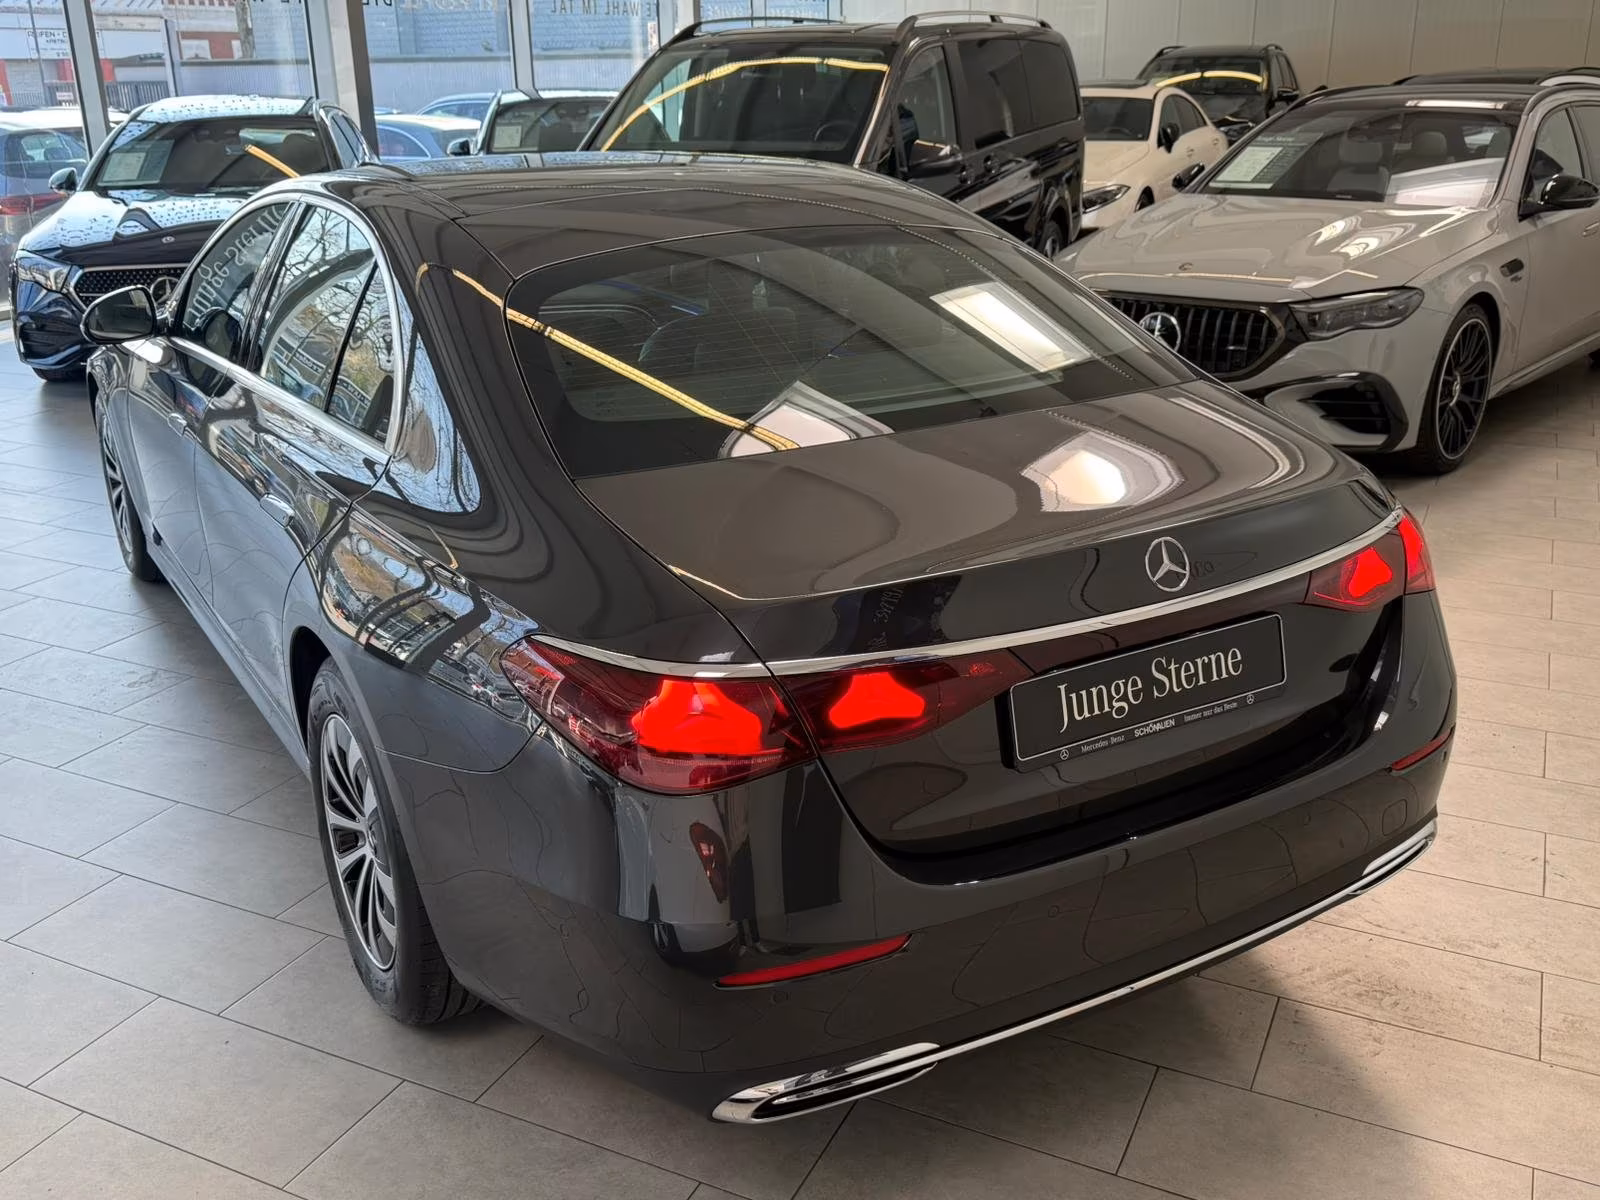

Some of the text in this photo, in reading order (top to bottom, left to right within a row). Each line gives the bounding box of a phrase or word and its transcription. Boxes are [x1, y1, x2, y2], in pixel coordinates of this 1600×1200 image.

[1057, 647, 1243, 733] Junge Sterne
[1081, 735, 1125, 753] Mercedes-Benz
